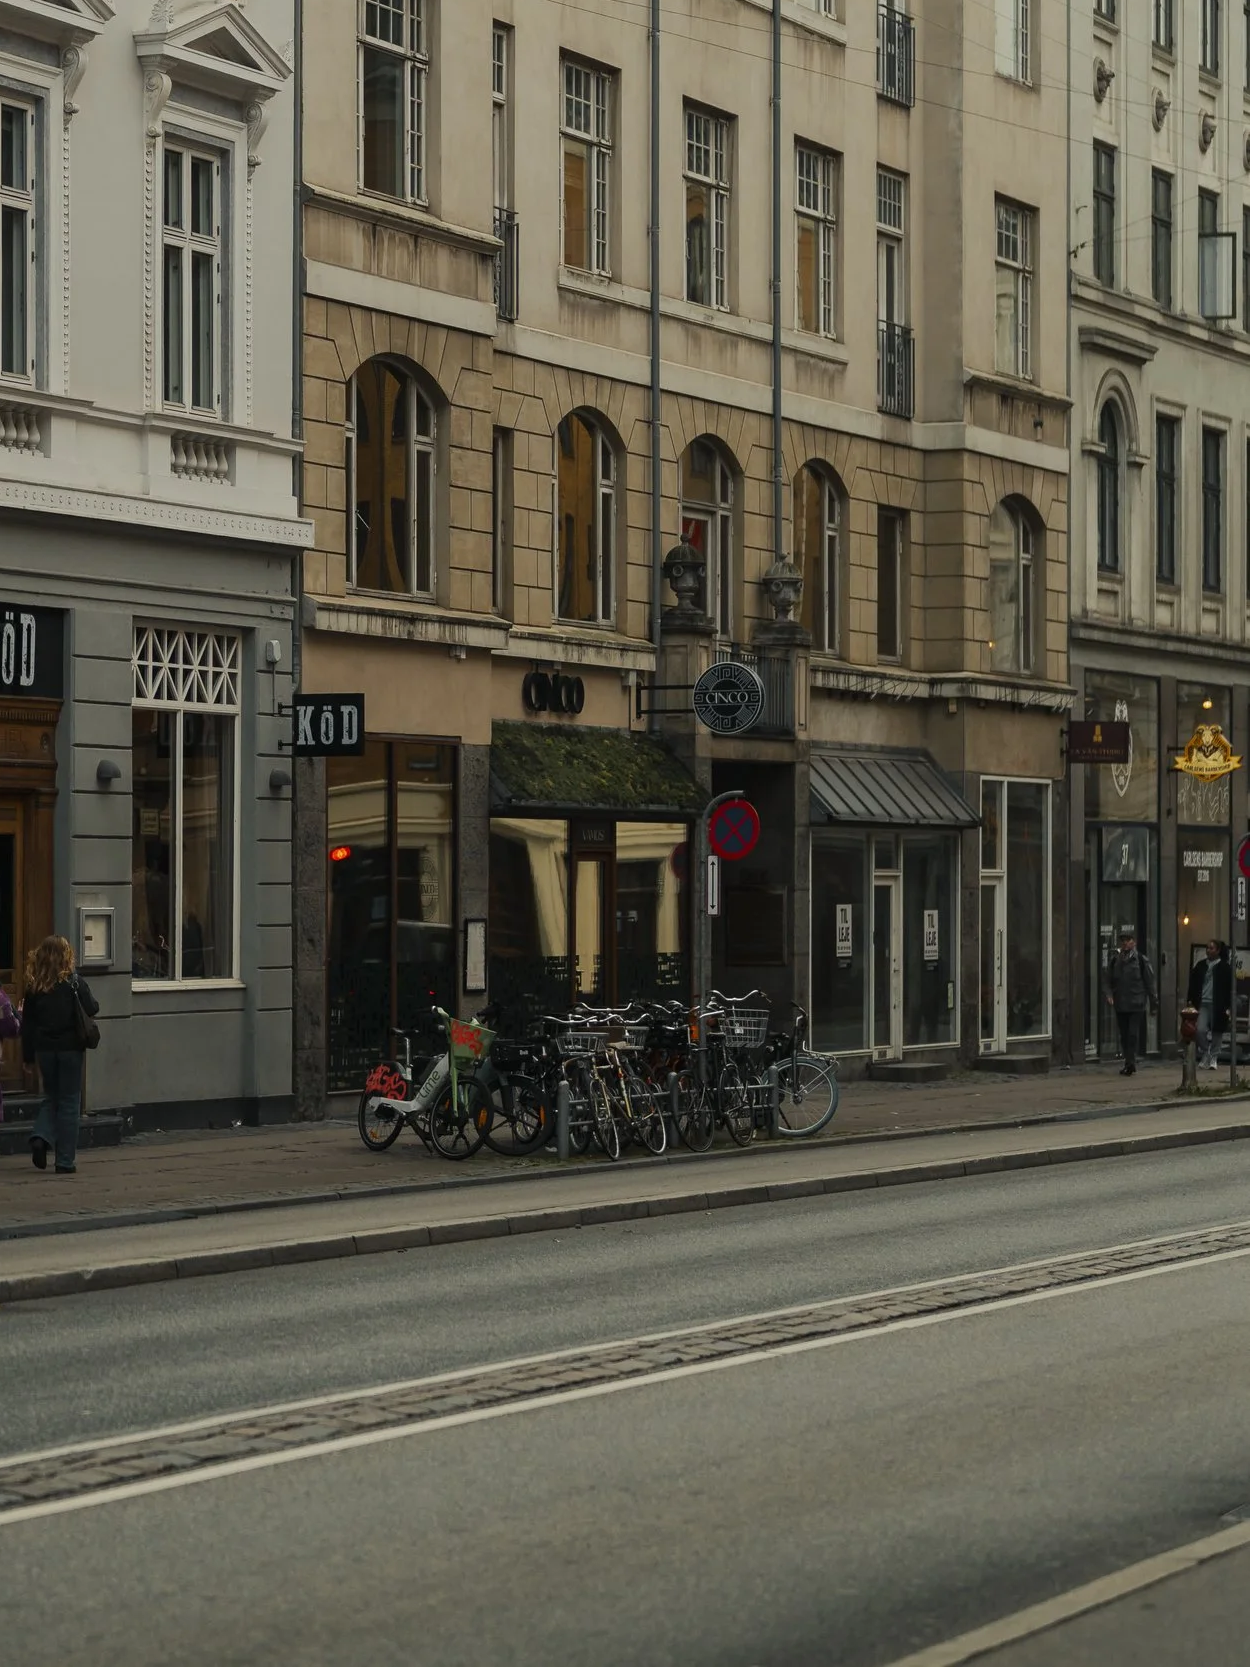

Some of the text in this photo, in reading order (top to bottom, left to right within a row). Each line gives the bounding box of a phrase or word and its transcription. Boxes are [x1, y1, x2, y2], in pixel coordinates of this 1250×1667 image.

[705, 691, 749, 705] CINCO
[296, 704, 358, 745] KöD
[840, 908, 848, 924] TIL
[927, 913, 935, 928] TIL
[838, 927, 850, 942] LEJE
[925, 931, 937, 946] LEJE
[419, 1070, 441, 1098] Lime
